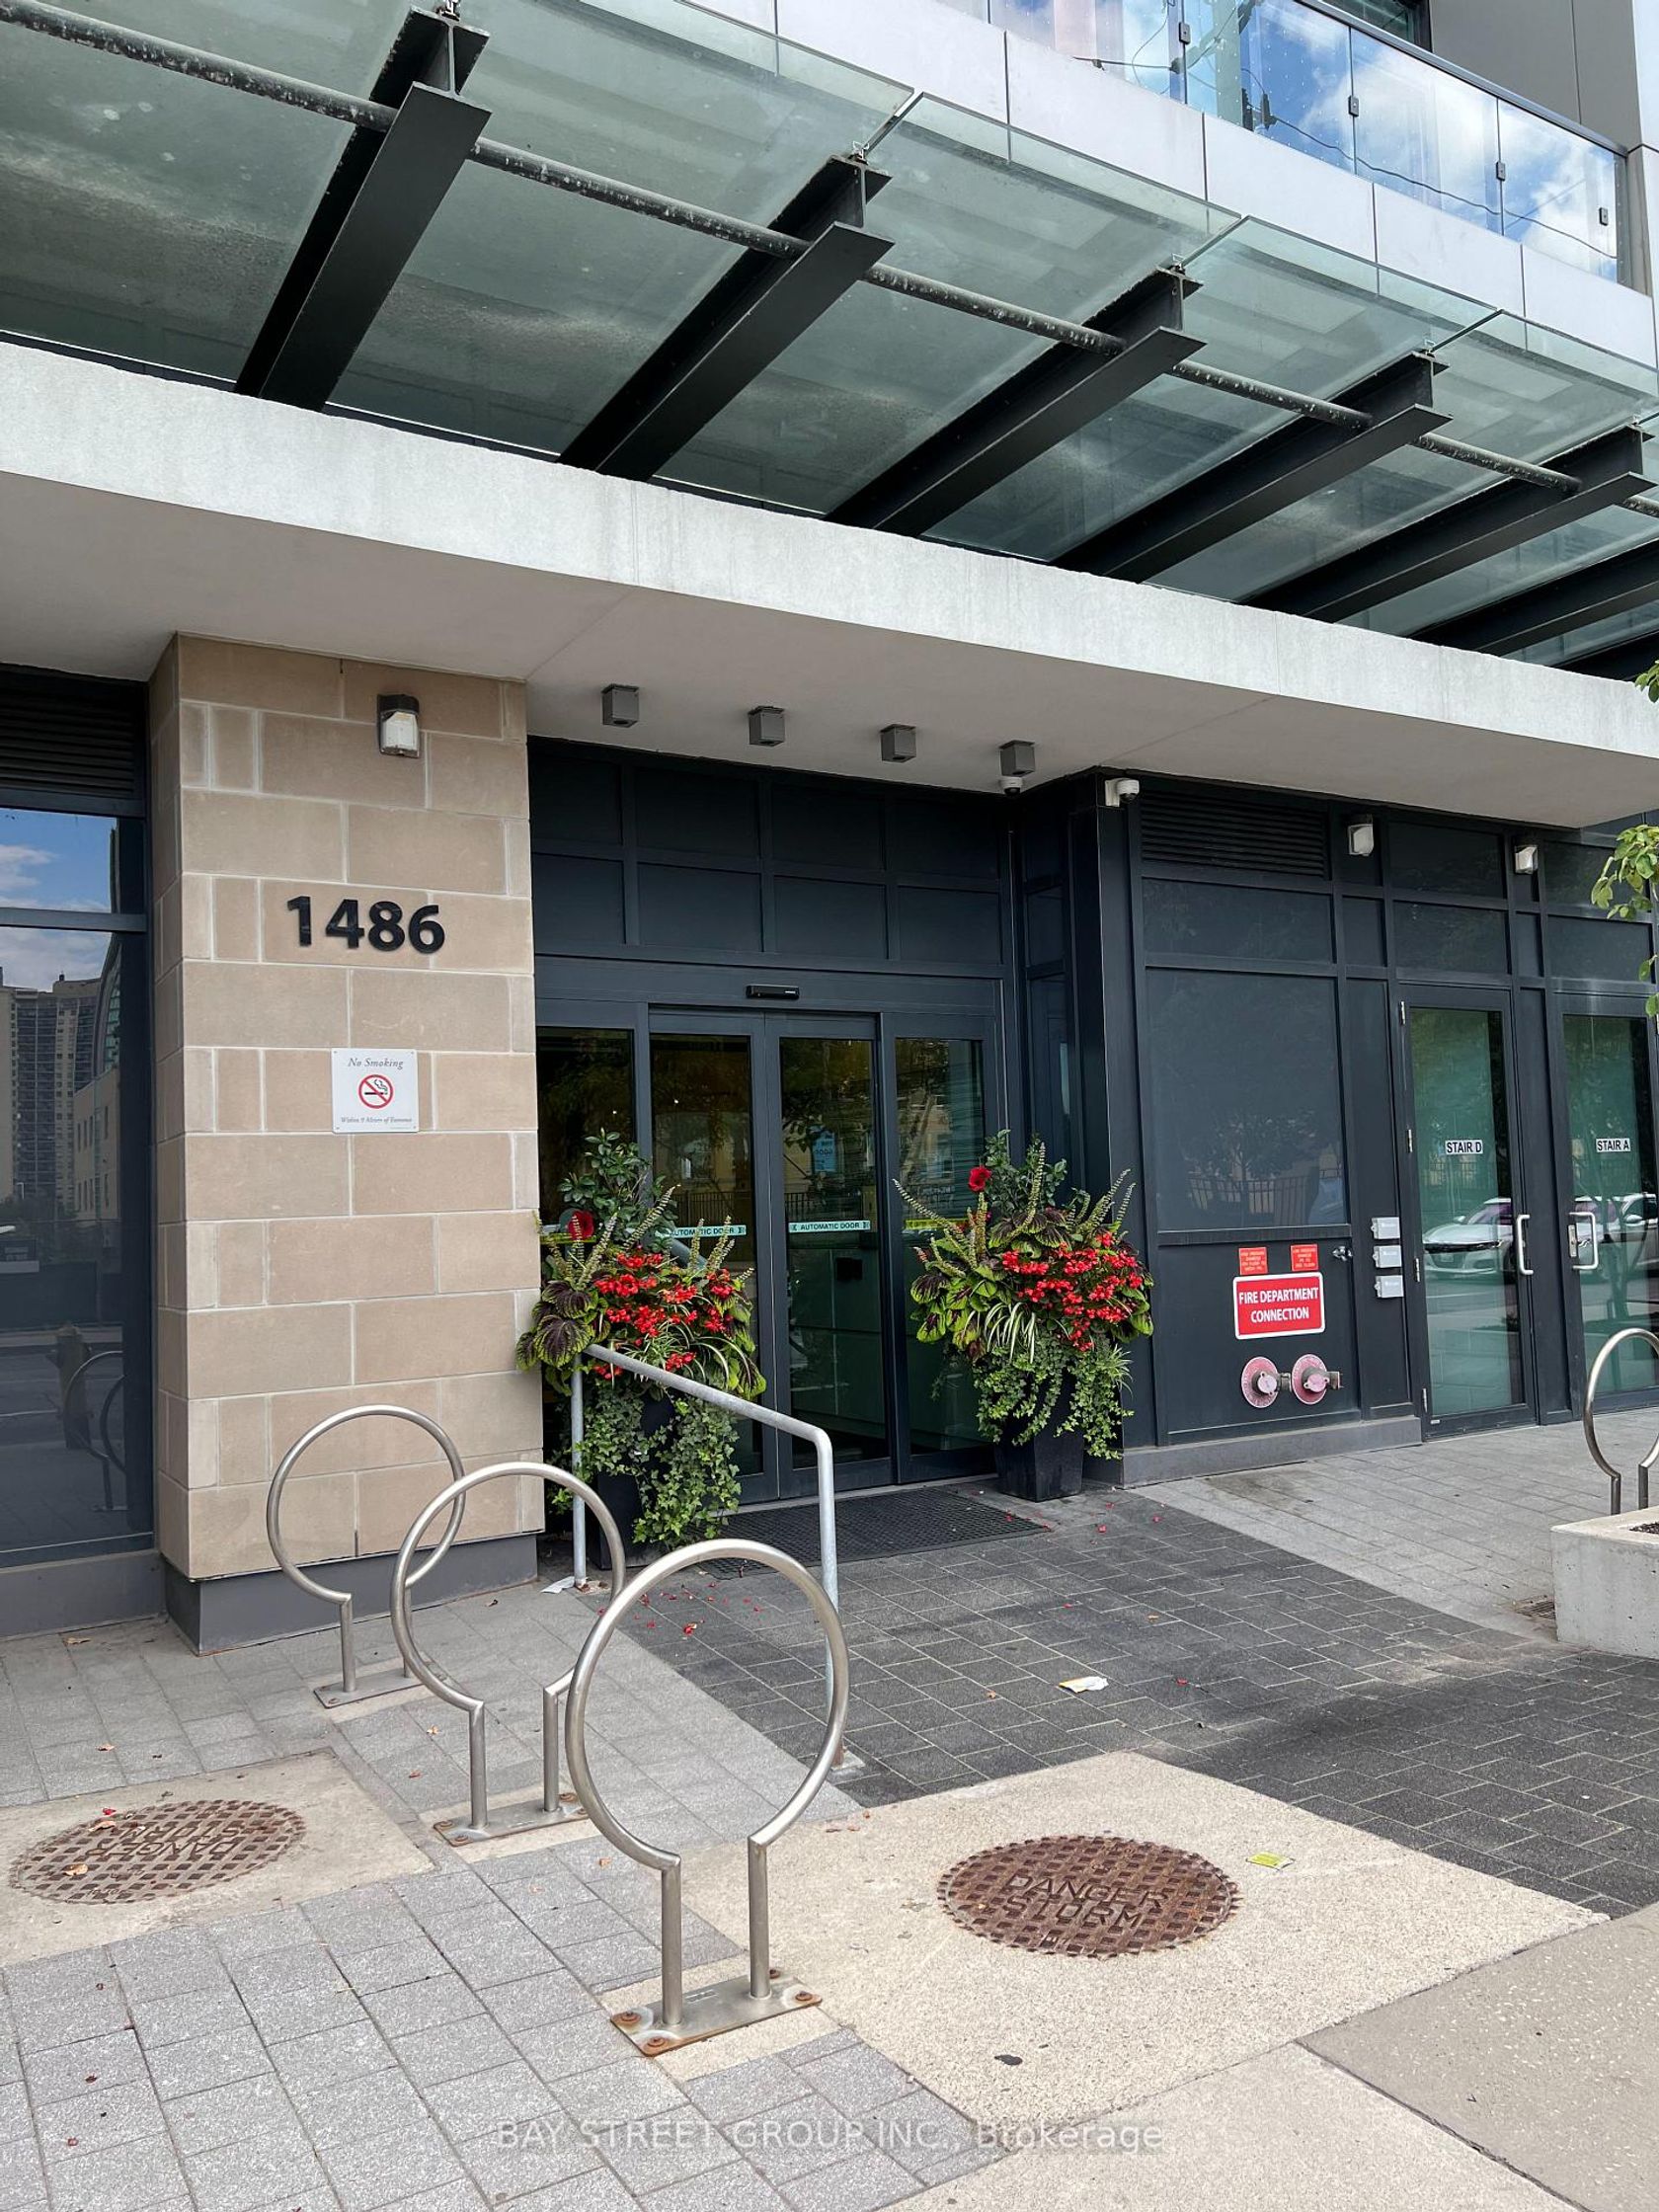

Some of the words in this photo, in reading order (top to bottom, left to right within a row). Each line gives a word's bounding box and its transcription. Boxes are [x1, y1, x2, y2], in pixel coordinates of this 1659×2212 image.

[286, 895, 445, 954] 1486
[348, 1058, 361, 1066] No
[364, 1058, 404, 1069] Smoking
[1447, 1142, 1473, 1153] STAIR
[1475, 1142, 1482, 1153] D
[1597, 1140, 1621, 1151] STAIR
[1622, 1140, 1629, 1150] A
[1239, 1292, 1258, 1304] FIRE
[1260, 1287, 1318, 1304] DEPARTMENT
[1250, 1306, 1309, 1323] CONNECTION
[119, 1825, 239, 1839] STORM
[86, 1840, 239, 1857] DANGER
[1006, 1874, 1168, 1908] DANGER
[1001, 1894, 1143, 1928] STORM
